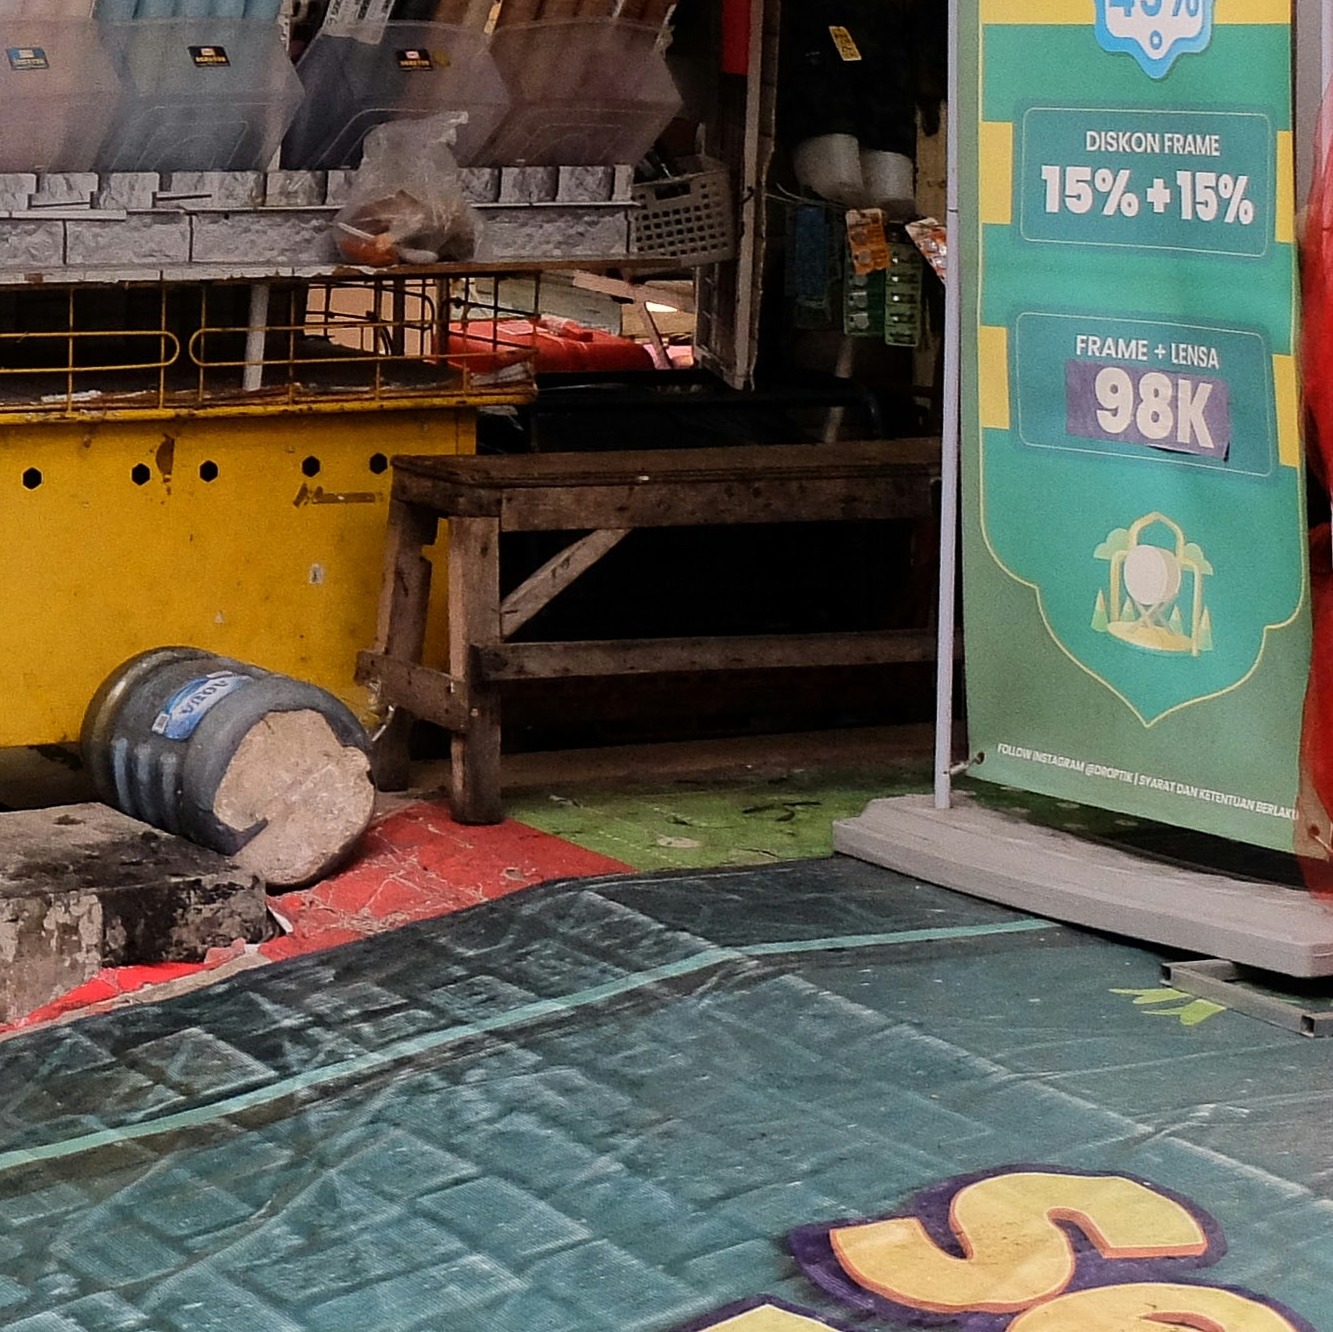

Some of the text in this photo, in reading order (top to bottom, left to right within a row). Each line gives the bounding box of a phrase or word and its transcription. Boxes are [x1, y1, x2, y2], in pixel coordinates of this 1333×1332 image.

[1086, 130, 1220, 156] DISKON FRAME
[1076, 335, 1220, 369] FRAME + LENSA
[1094, 366, 1215, 449] 98K
[997, 743, 1032, 761] FOLLOW
[1032, 749, 1084, 772] INSTAGRAM
[1085, 762, 1133, 784] @DROPTIK
[1139, 773, 1176, 794] SYARAT
[1176, 783, 1198, 798] DAN
[1198, 787, 1255, 812] KETENTUAN
[1255, 800, 1299, 820] BERLAKU
